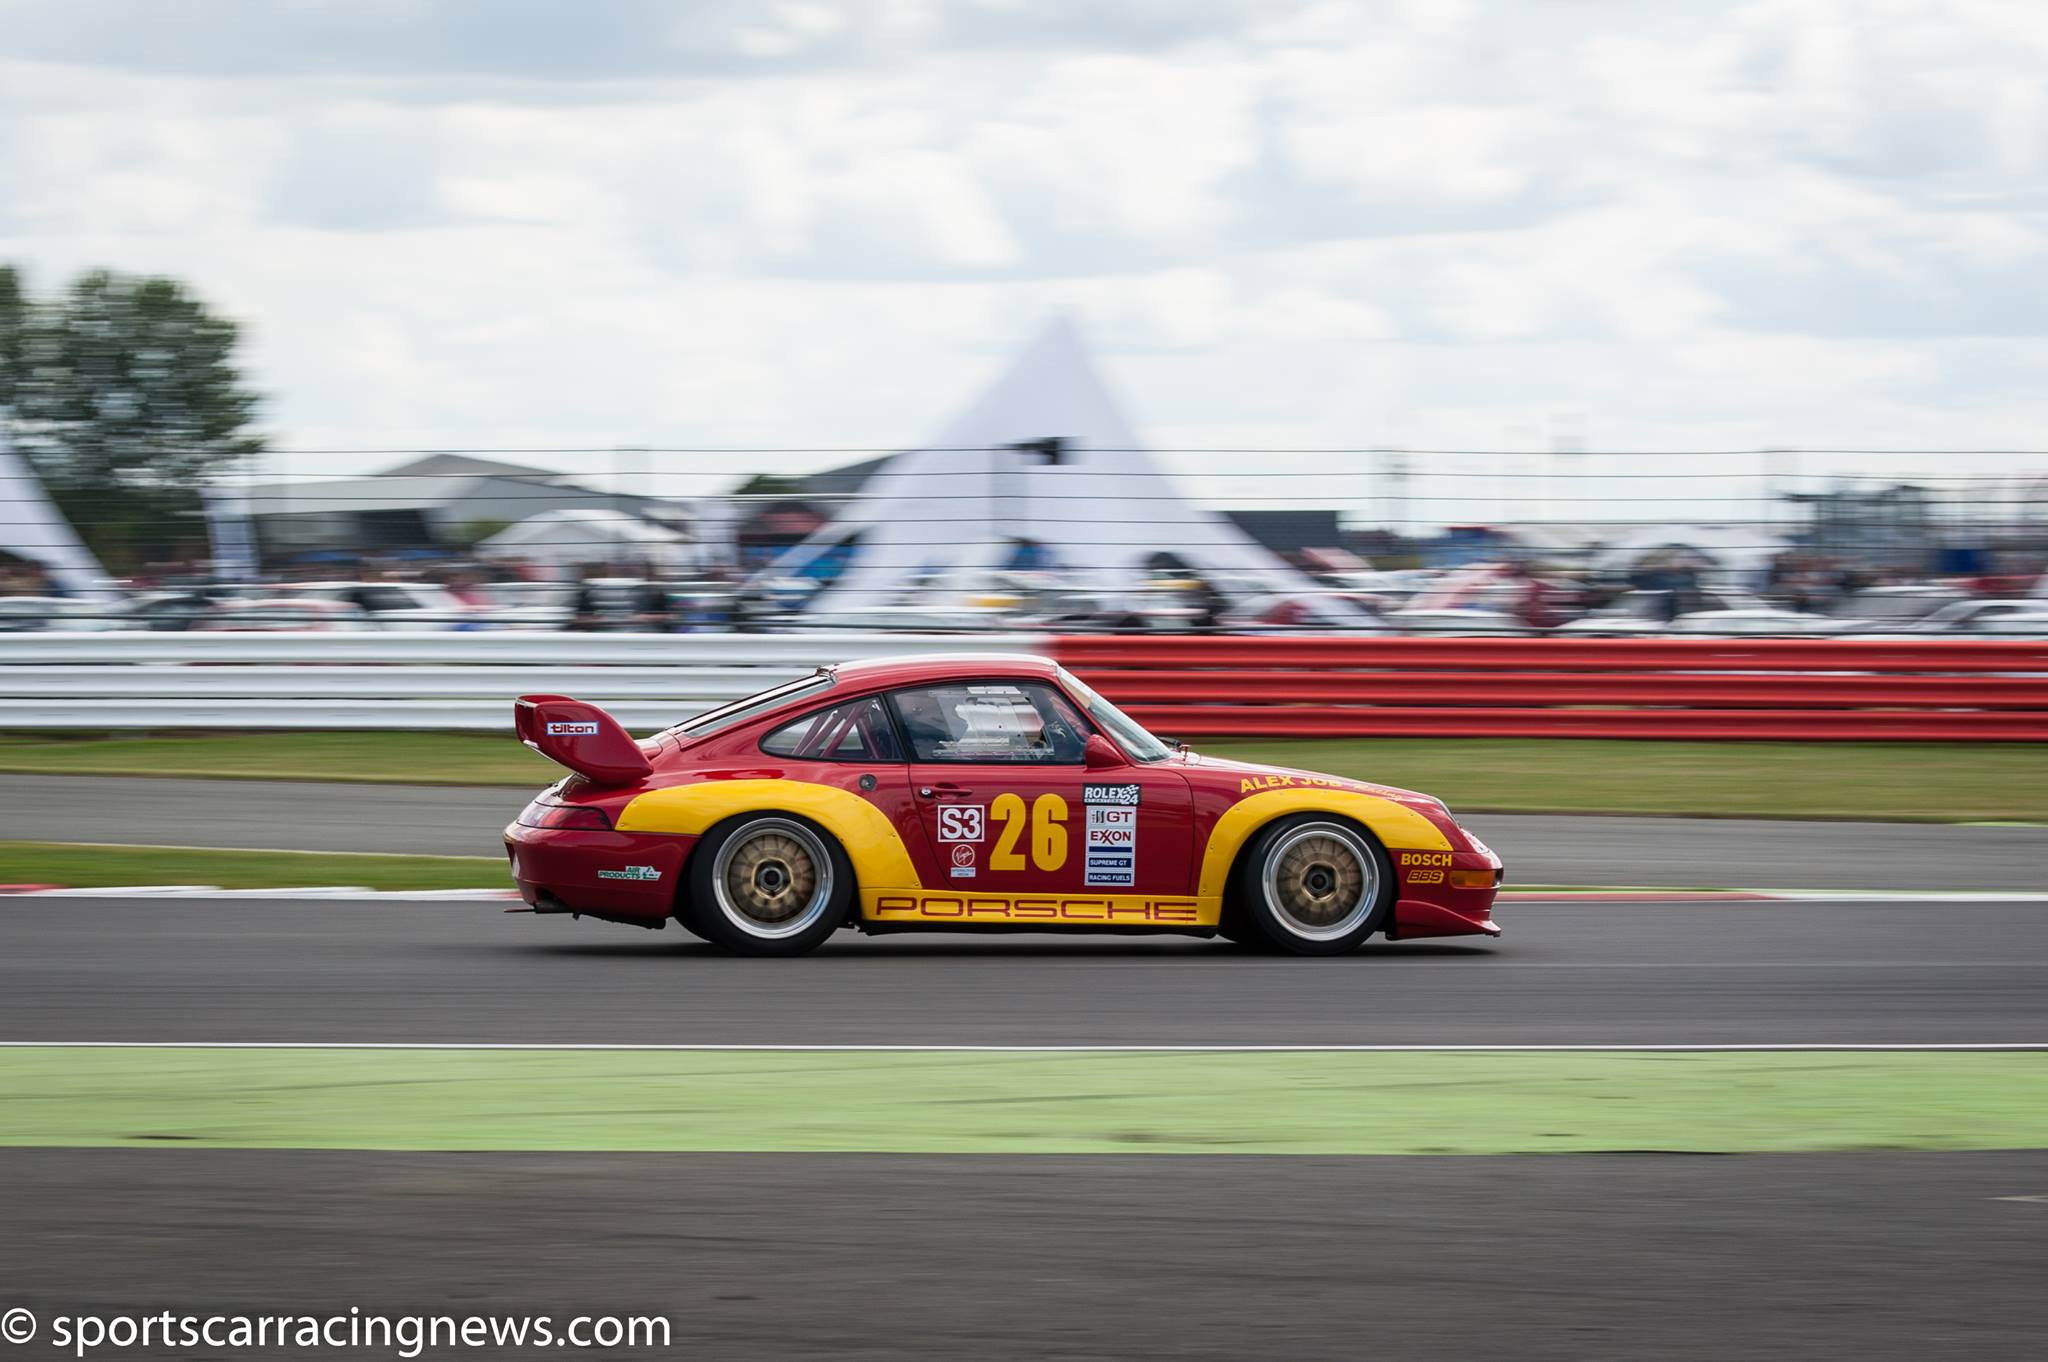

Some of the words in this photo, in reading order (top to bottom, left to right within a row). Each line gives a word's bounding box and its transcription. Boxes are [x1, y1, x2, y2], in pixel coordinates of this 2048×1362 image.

[551, 724, 594, 733] tilton
[1240, 775, 1297, 793] ALEX
[1084, 787, 1125, 799] ROLEX
[1121, 793, 1139, 805] 24
[941, 808, 981, 839] S3
[1106, 811, 1133, 823] GT
[989, 793, 1069, 871] 26
[1090, 829, 1131, 845] EXXON
[1401, 853, 1453, 867] BOSCH
[1408, 870, 1444, 883] BBS
[876, 896, 1197, 921] PORSCHE
